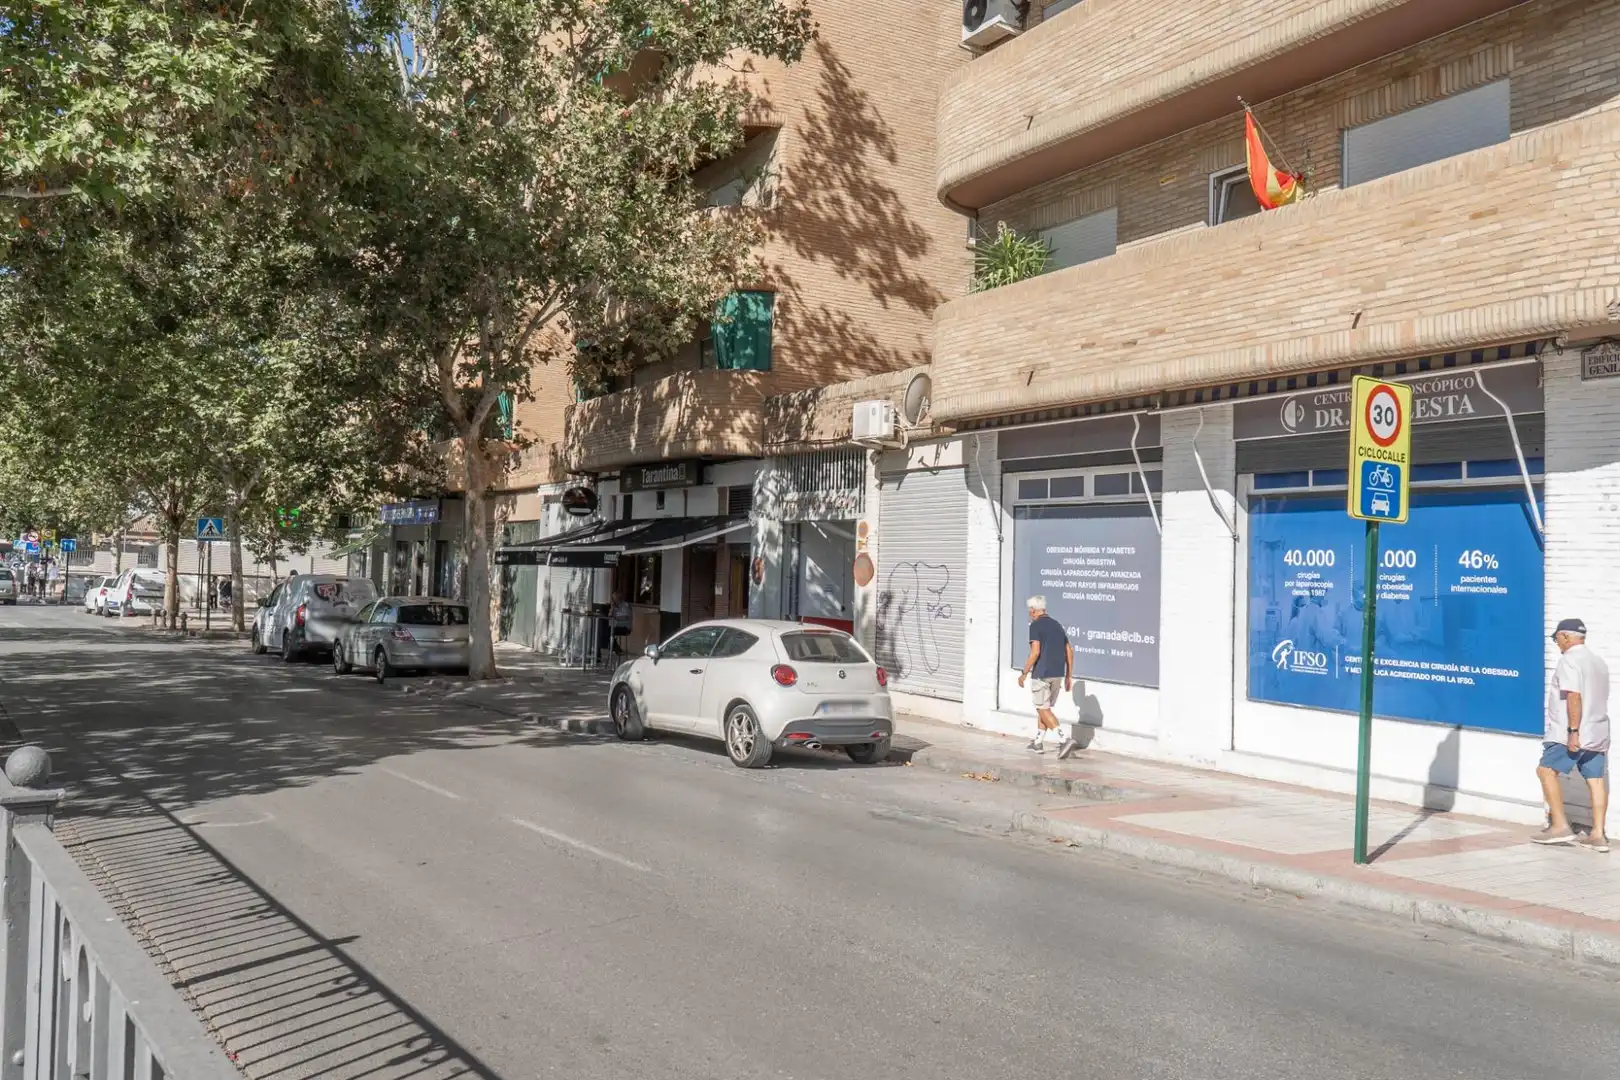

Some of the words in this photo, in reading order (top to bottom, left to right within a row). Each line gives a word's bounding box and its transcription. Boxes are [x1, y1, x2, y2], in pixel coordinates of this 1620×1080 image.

[1314, 391, 1352, 406] CENTR
[1315, 408, 1350, 428] DR.
[1373, 404, 1394, 427] 30
[1358, 446, 1406, 463] CICLOCALLE
[641, 464, 679, 484] Tarantina
[1106, 546, 1136, 555] DIABETES
[1063, 557, 1086, 565] CIRUGÍA
[1086, 558, 1116, 566] DIGESTIVA
[1283, 549, 1336, 566] 40.000
[1379, 550, 1417, 568] .000
[1458, 550, 1499, 569] 46%
[1040, 568, 1062, 577] CIRUGÍA
[1063, 569, 1110, 578] LAPAROSCÓPICA
[1110, 571, 1142, 579] AVANZADA
[1297, 571, 1321, 580] cirugías
[1379, 572, 1406, 582] cirugías
[1460, 575, 1498, 584] pacientes
[1042, 579, 1064, 588] CIRUGÍA
[1065, 581, 1077, 589] CON
[1078, 581, 1097, 589] RAYOS
[1098, 582, 1139, 592] INFRARROJOS
[1284, 580, 1295, 588] por
[1381, 583, 1413, 591] obesidad
[1450, 584, 1508, 594] internacionales
[1062, 591, 1085, 600] CIRUGÍA
[1086, 592, 1116, 602] ROBÓTICA
[1380, 592, 1410, 600] diabetes
[1066, 626, 1080, 637] 491
[1087, 629, 1155, 644] granada@clb.es
[1074, 645, 1105, 655] Barcelona
[1111, 648, 1133, 657] Madrid
[1293, 650, 1327, 668] IFSO
[1380, 658, 1420, 669] EXCELENCIA
[1420, 661, 1430, 669] EN
[1431, 662, 1459, 672] CIRUGÍA
[1460, 665, 1470, 673] DE
[1471, 666, 1481, 674] LA
[1481, 667, 1519, 677] OBESIDAD
[1390, 671, 1430, 681] ACREDITADO
[1431, 674, 1446, 683] POR
[1446, 675, 1456, 684] LA
